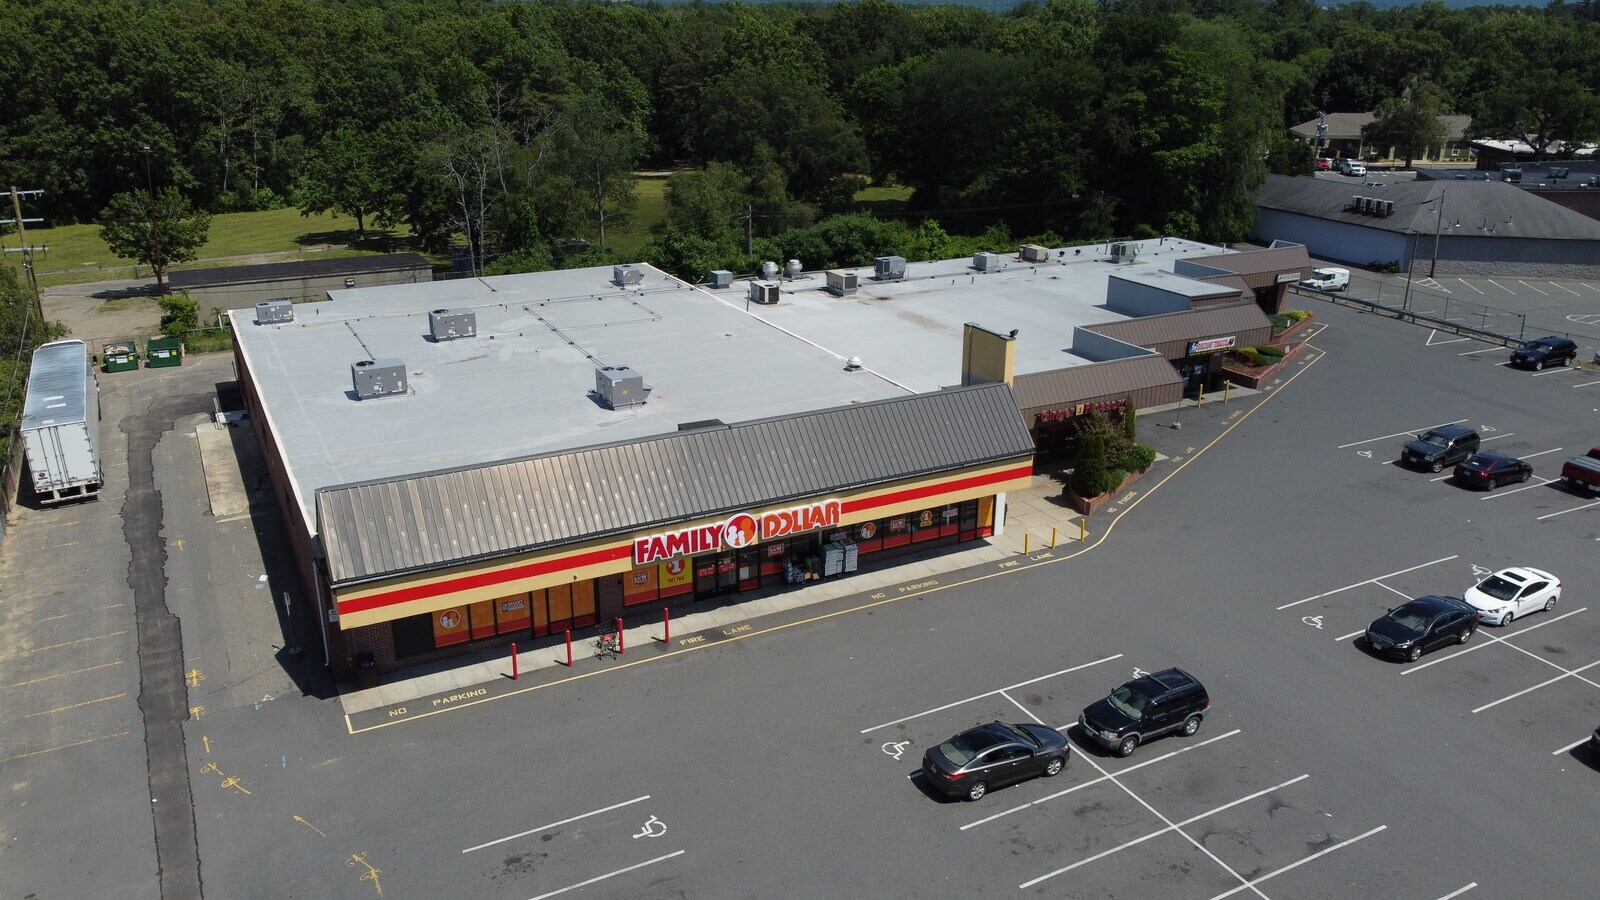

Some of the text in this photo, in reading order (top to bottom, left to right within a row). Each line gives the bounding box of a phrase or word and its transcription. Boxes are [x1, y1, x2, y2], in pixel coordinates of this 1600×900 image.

[635, 500, 841, 565] FAMILY DOLLAR
[998, 552, 1055, 569] FIRE LANE
[667, 575, 685, 584] WOW
[870, 579, 939, 600] NO PARKING
[679, 624, 753, 646] FIRE LANE
[388, 688, 488, 718] NO PARKING
